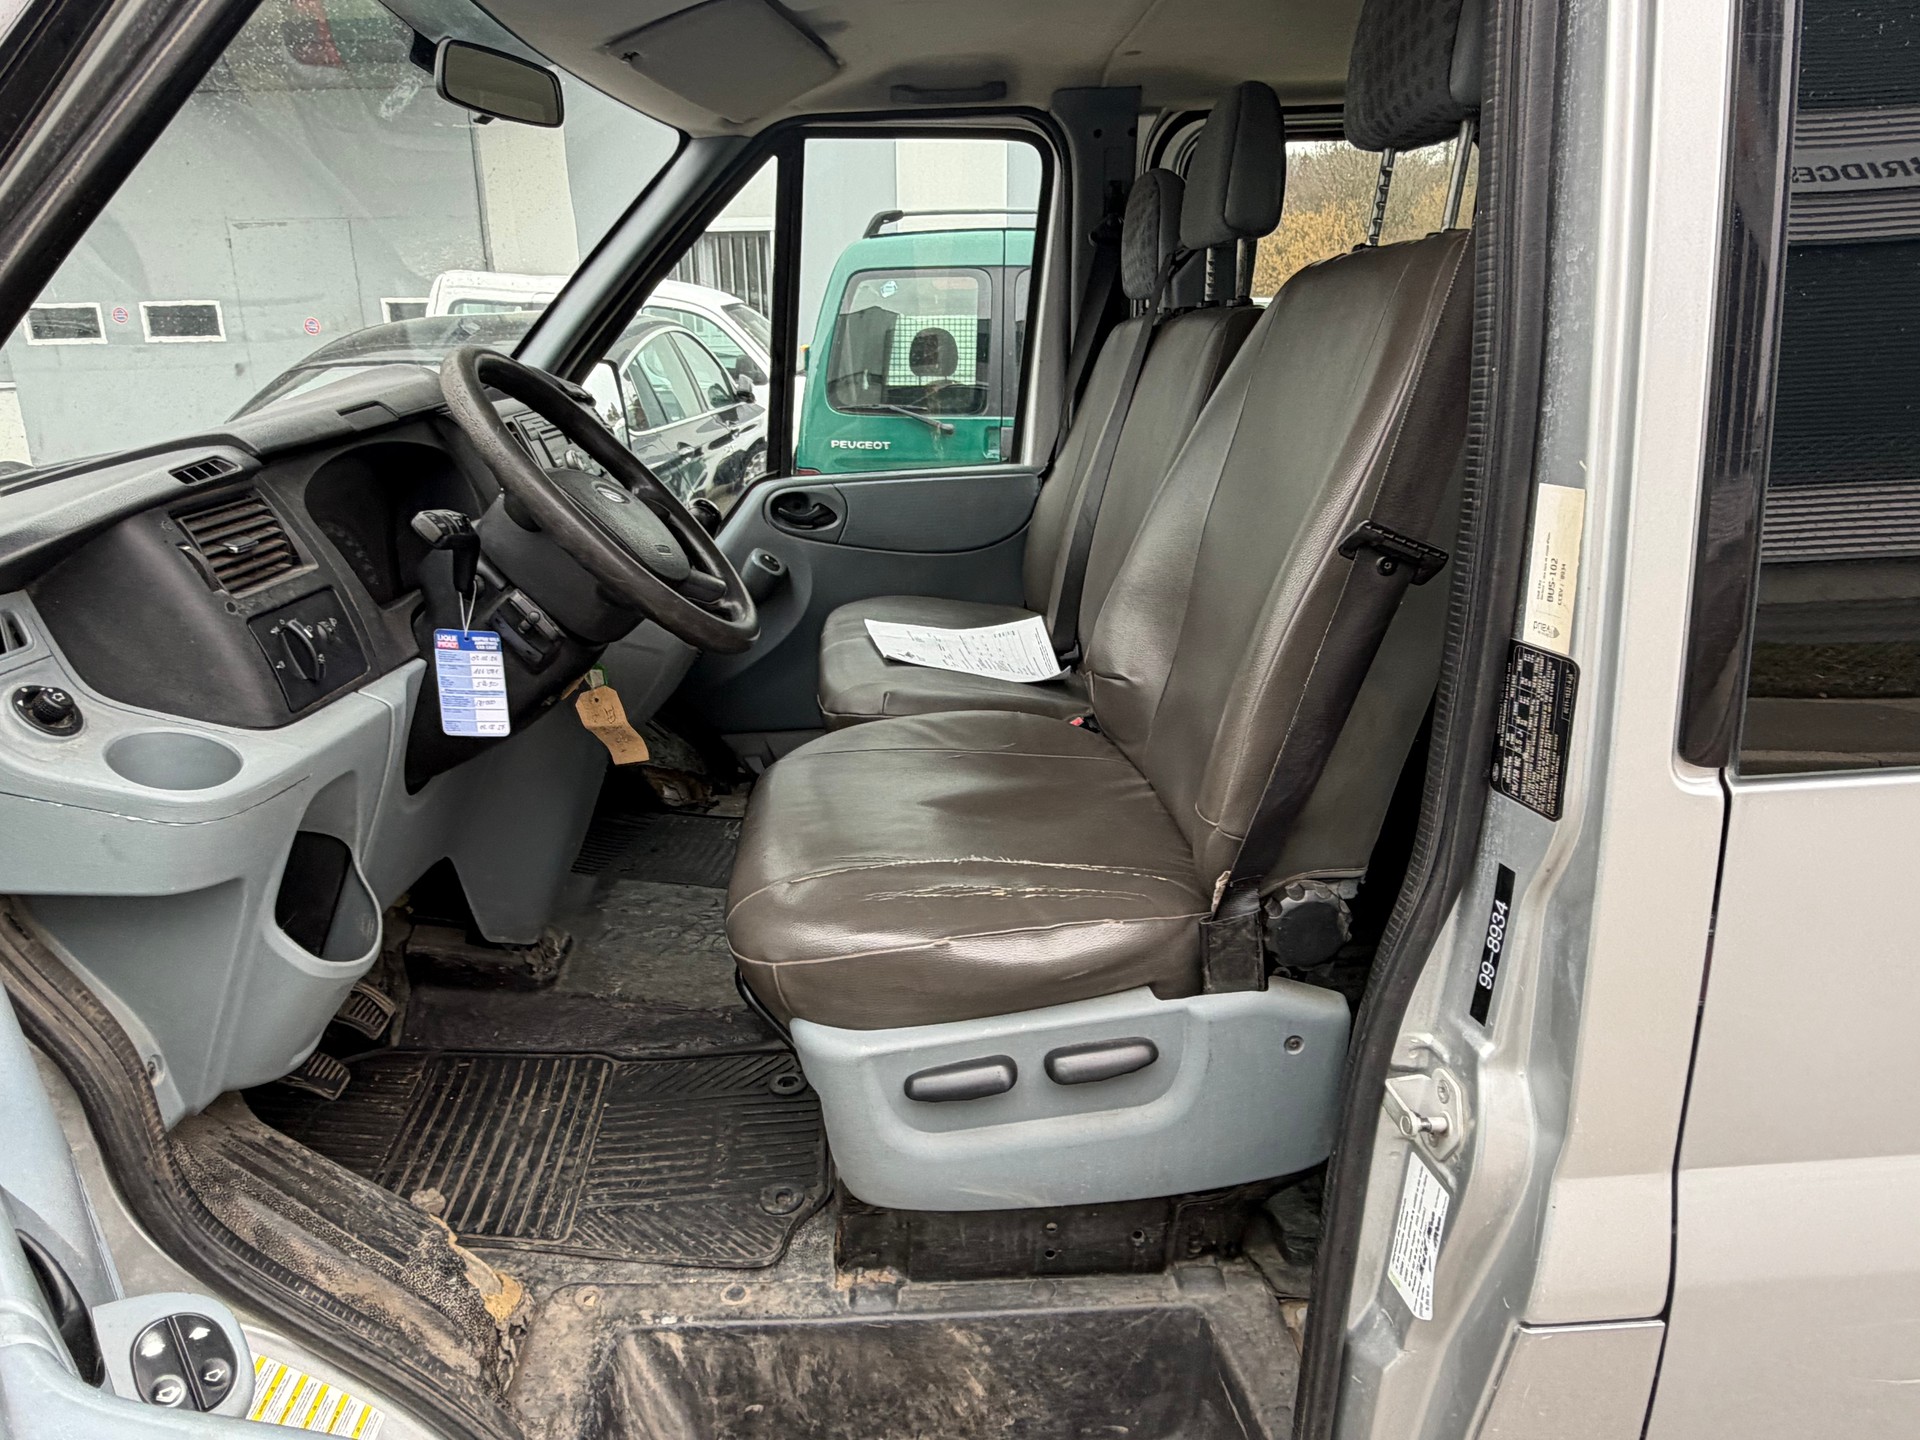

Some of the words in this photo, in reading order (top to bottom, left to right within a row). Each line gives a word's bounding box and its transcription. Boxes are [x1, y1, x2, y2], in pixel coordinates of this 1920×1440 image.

[830, 440, 891, 450] PEUGEOT
[1546, 557, 1558, 603] BUS-102
[1478, 899, 1509, 991] 99-8934
